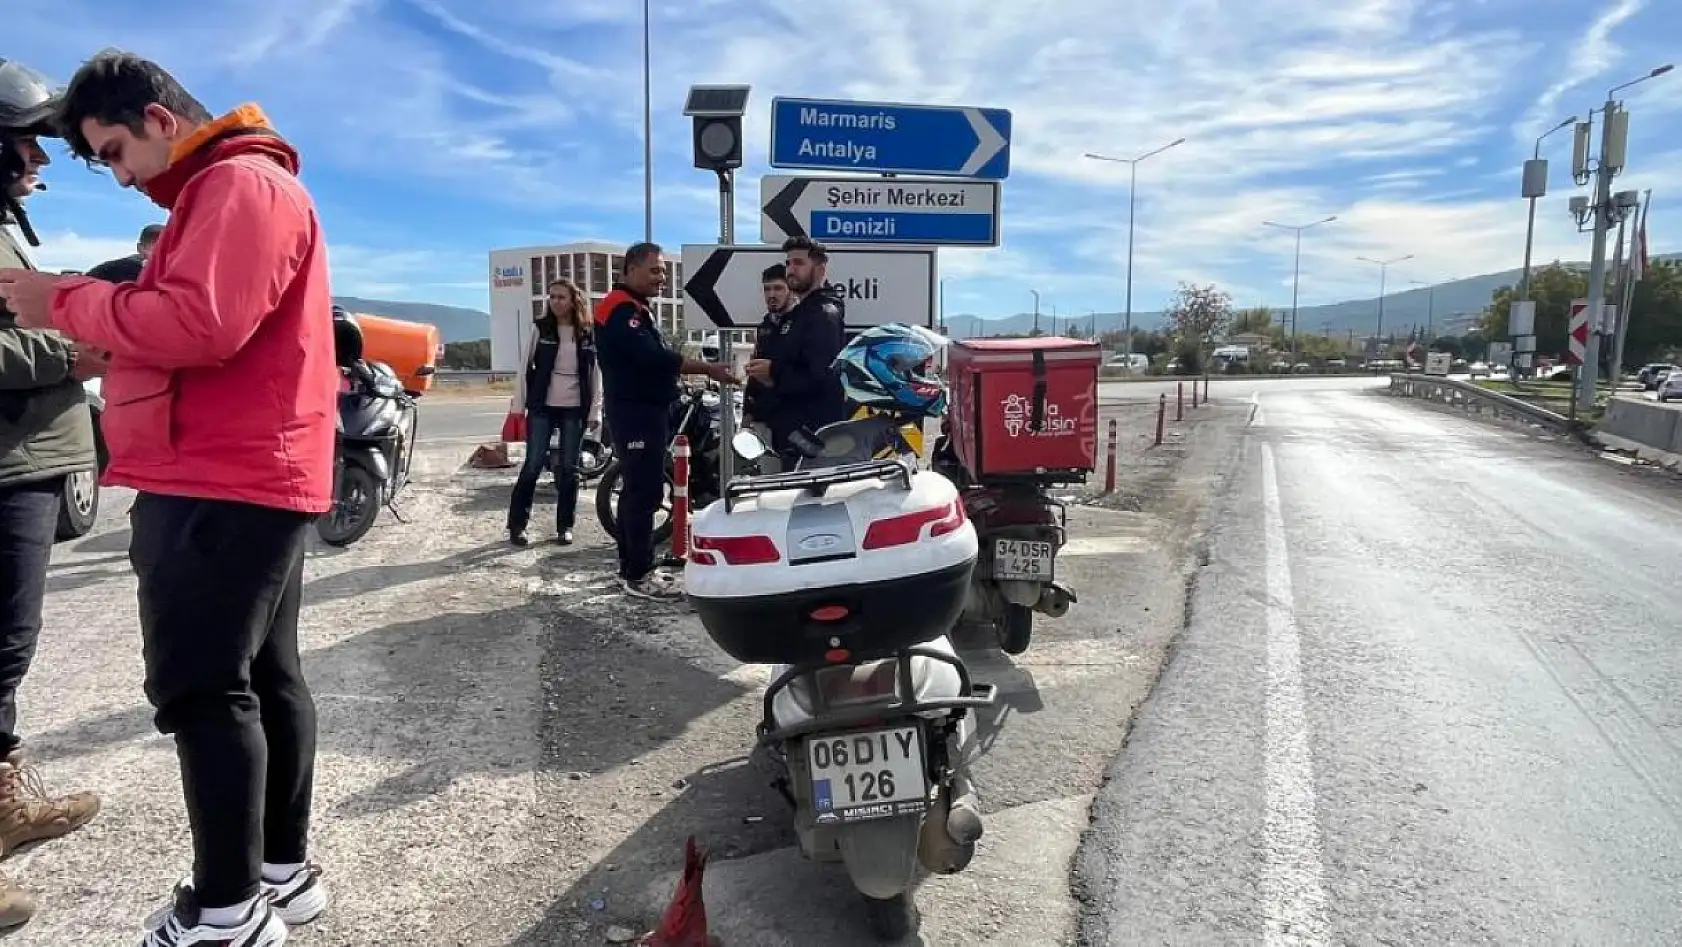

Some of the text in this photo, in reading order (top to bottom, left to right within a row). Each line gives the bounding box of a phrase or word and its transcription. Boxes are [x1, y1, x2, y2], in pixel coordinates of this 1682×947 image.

[800, 107, 896, 130] Marmaris
[798, 138, 877, 162] Antalya
[827, 187, 965, 208] Şehir Merkezi
[826, 217, 896, 237] Denizli
[999, 540, 1049, 558] 34 DSR
[1011, 559, 1040, 574] 425
[844, 769, 896, 802] 126
